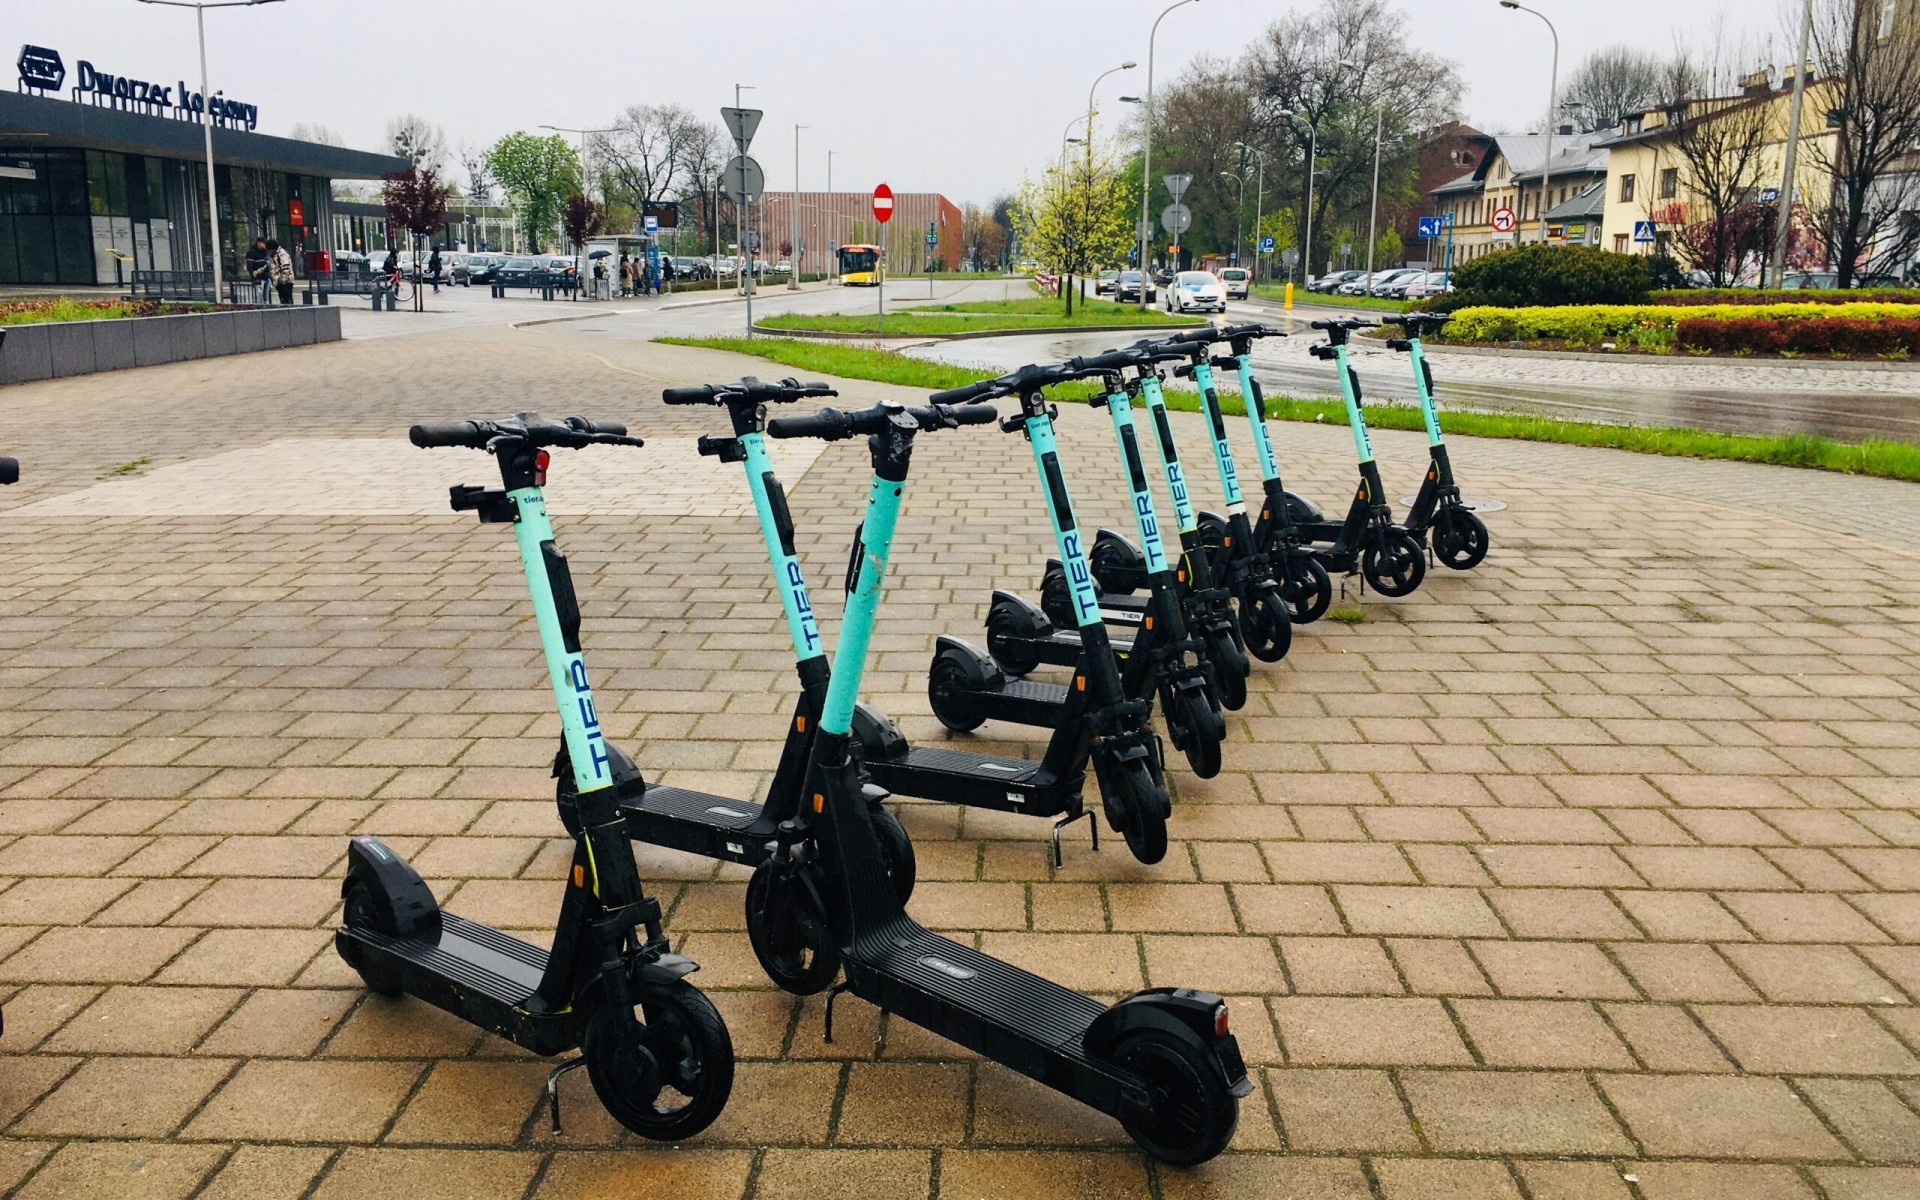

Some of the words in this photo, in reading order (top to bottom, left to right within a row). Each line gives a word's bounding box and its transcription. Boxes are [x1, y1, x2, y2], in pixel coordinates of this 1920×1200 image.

[77, 60, 172, 107] Dworzec
[1265, 238, 1273, 247] P
[1168, 463, 1191, 528] TIER
[1217, 441, 1239, 498] TIER
[1136, 492, 1163, 568] TIER
[786, 561, 819, 652] TIER
[1063, 532, 1097, 620] TIER
[1120, 612, 1141, 620] TIER
[570, 658, 608, 779] TIER
